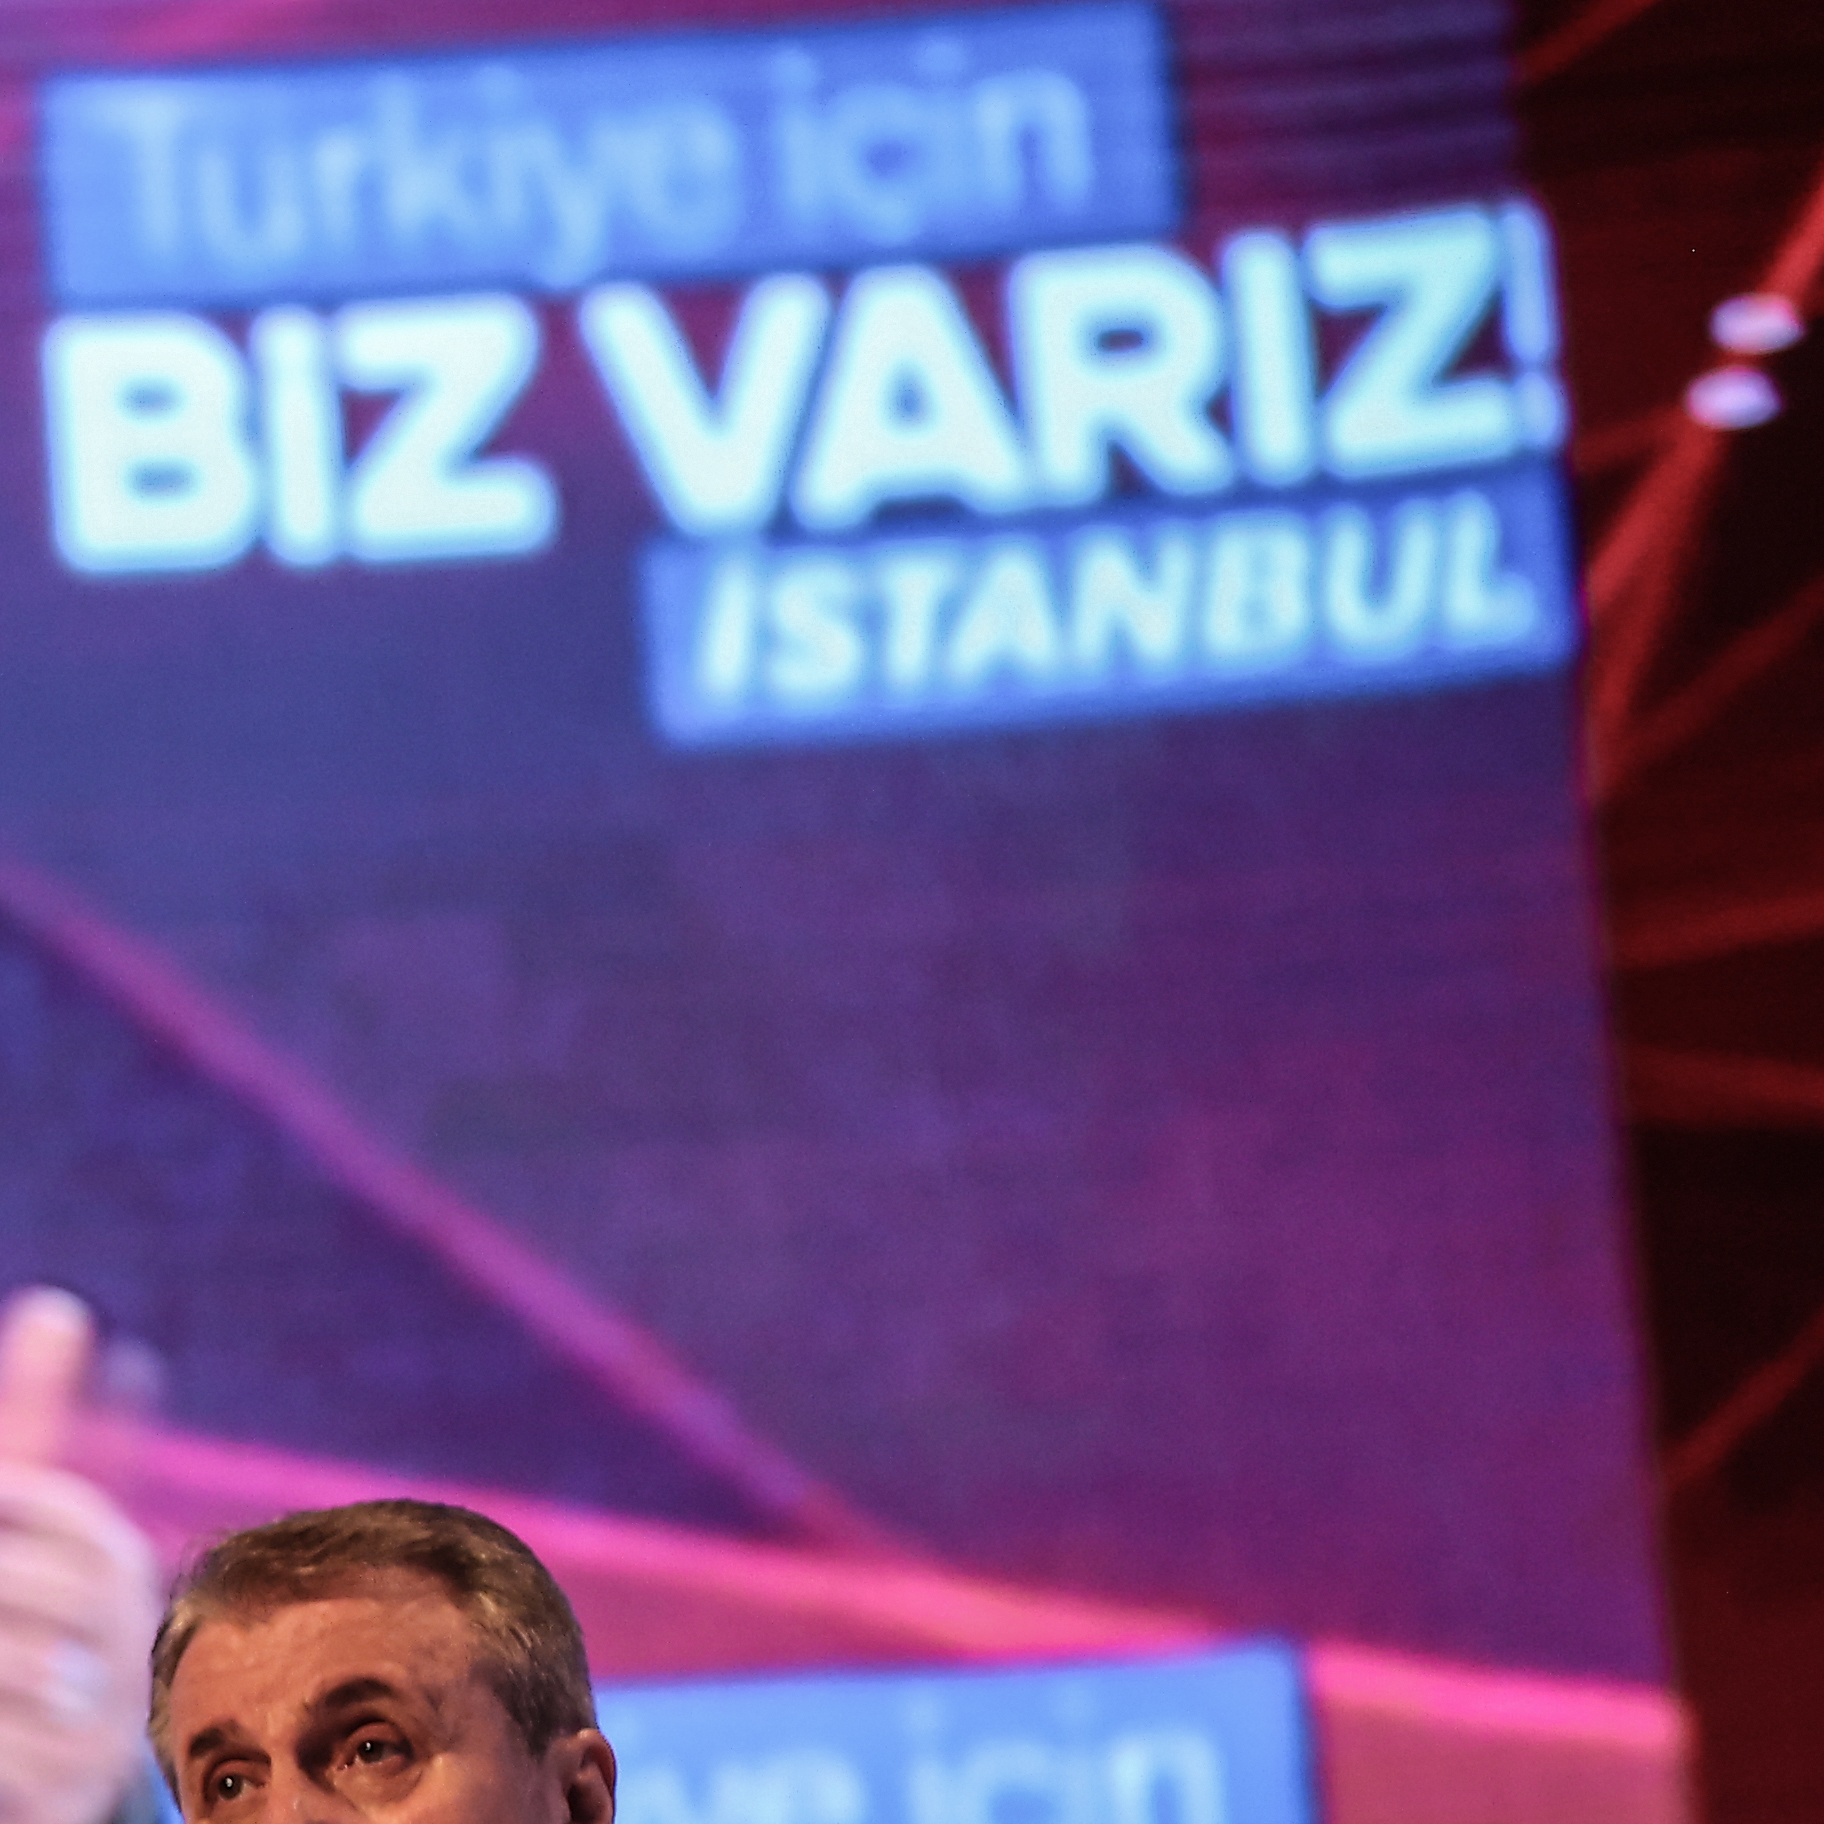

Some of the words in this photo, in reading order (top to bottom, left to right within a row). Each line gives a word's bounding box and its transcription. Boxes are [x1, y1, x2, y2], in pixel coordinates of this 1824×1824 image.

[772, 38, 1094, 242] için
[579, 198, 1566, 536] VARIZ!
[696, 490, 1540, 706] İSTANBUL
